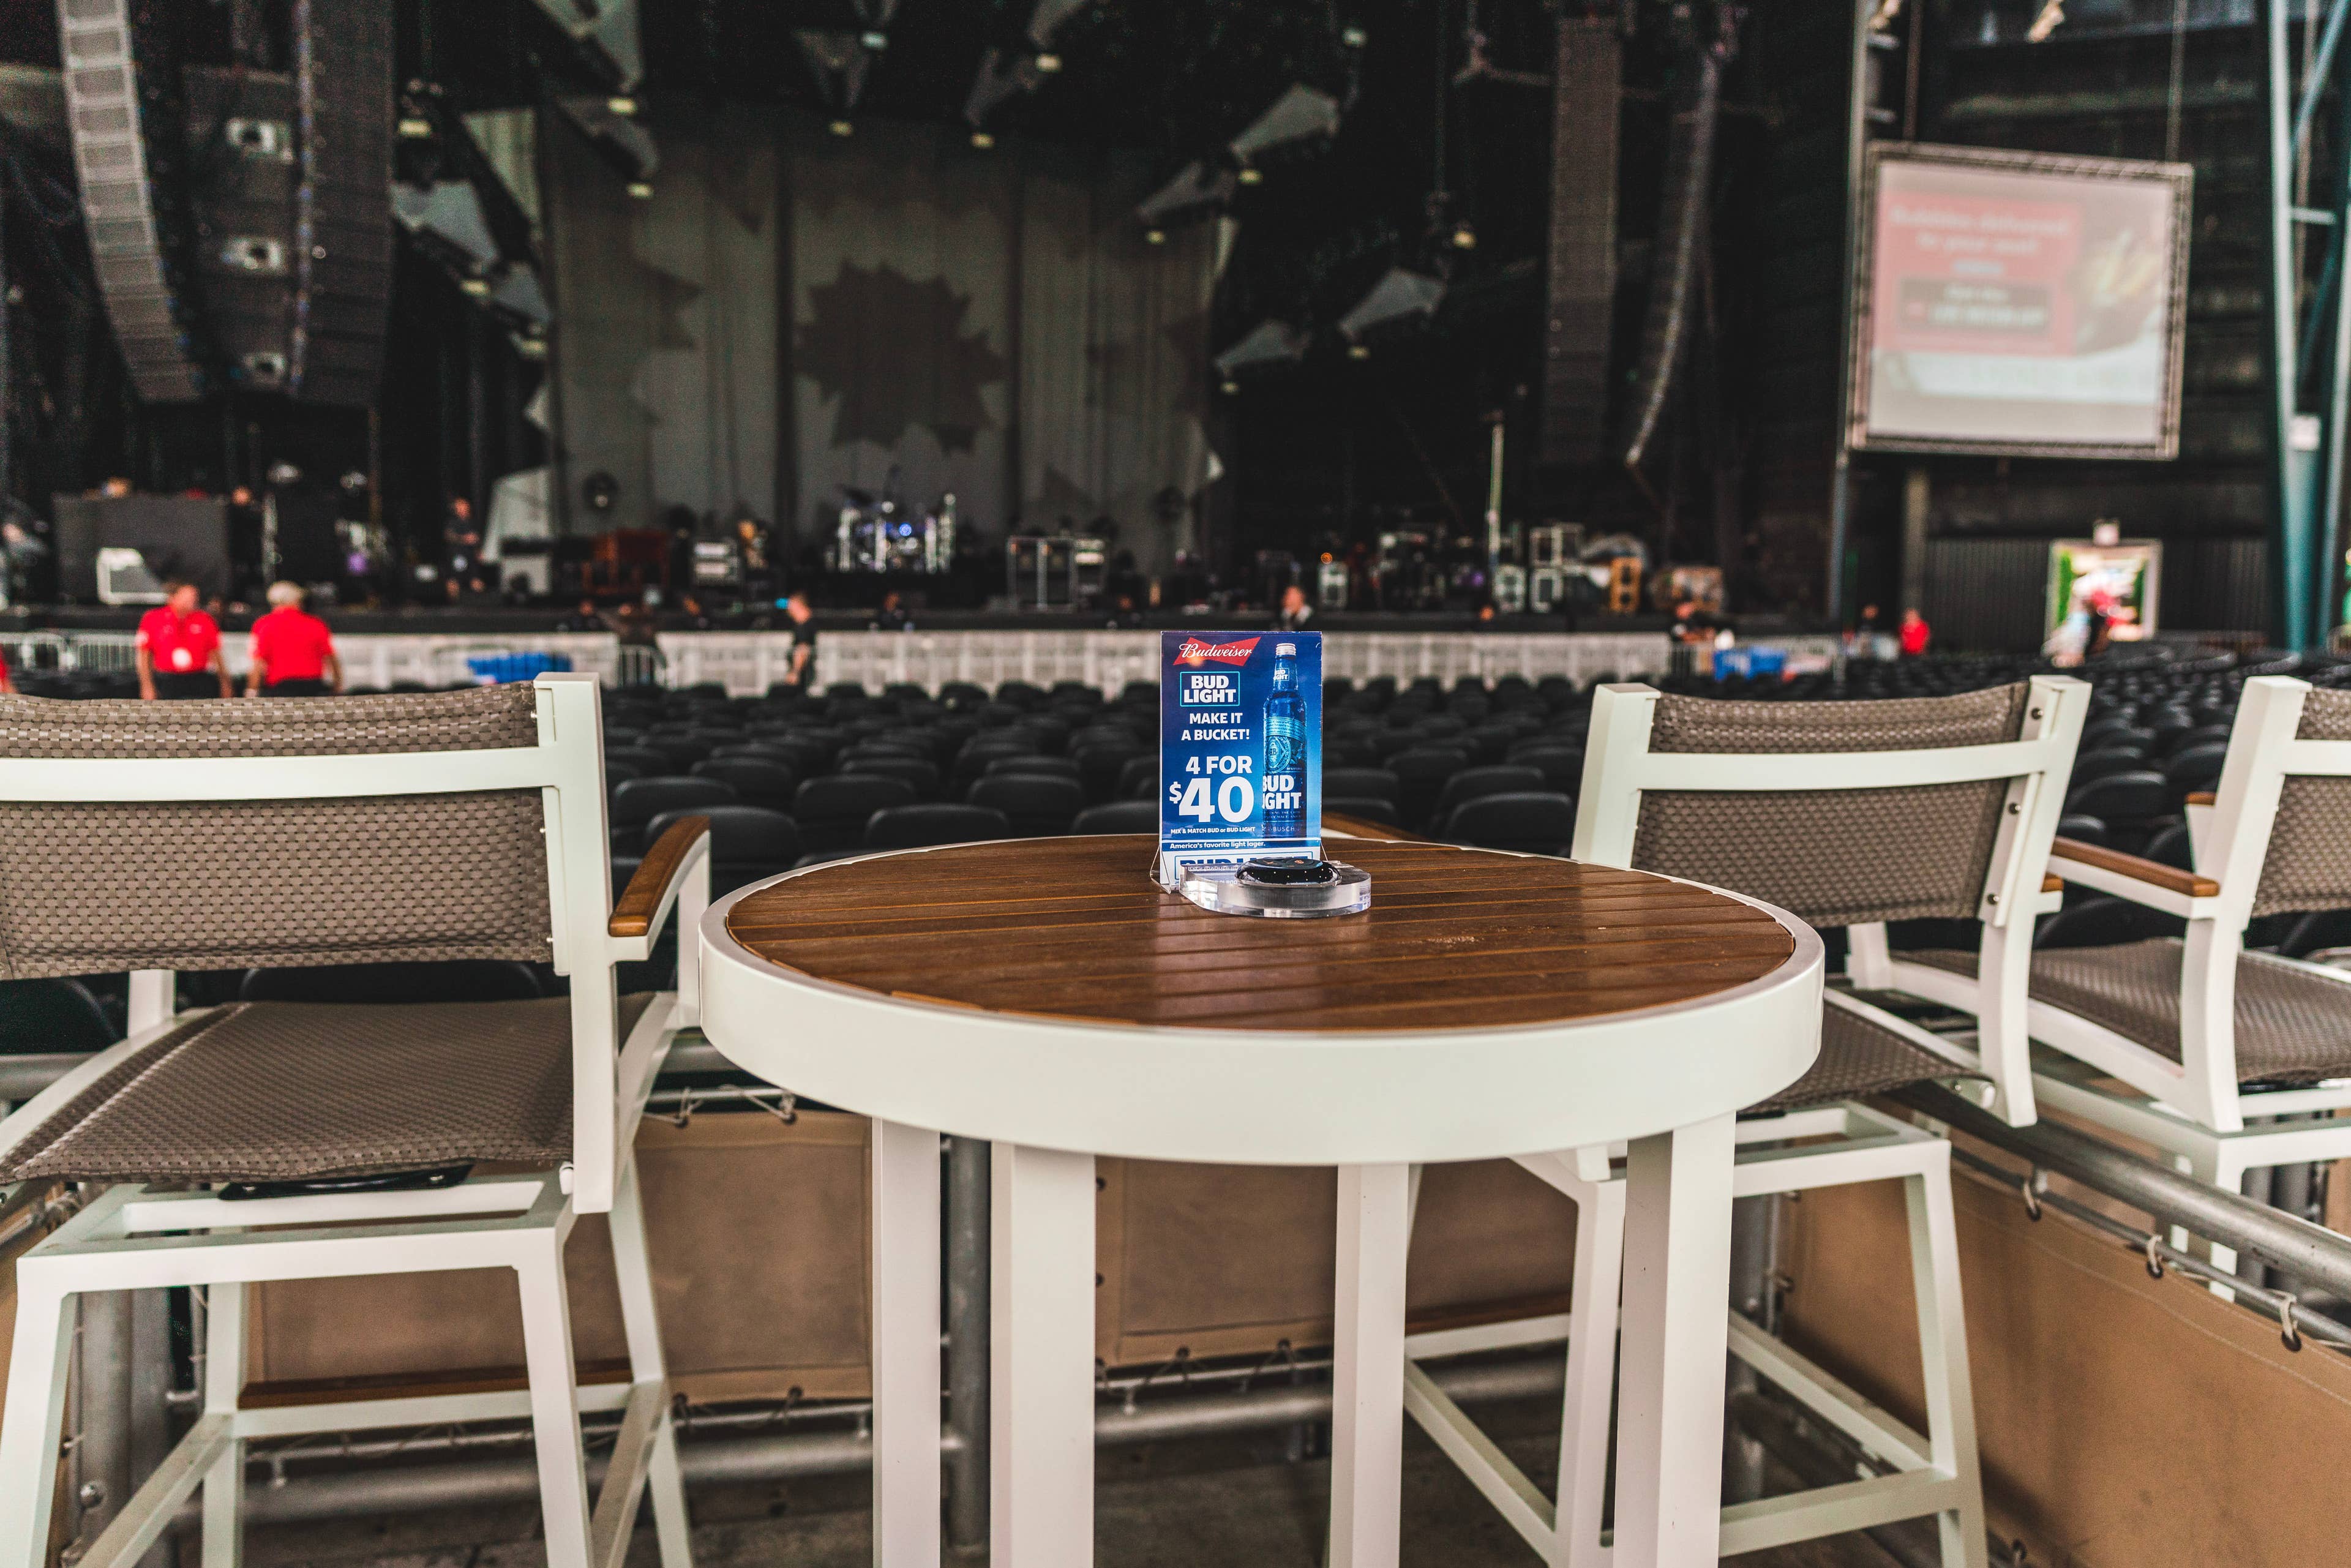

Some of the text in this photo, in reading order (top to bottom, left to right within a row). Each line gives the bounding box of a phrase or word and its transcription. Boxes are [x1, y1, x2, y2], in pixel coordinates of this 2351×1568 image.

[1179, 643, 1252, 658] Budweiser
[1191, 675, 1229, 689] BUD
[1183, 689, 1237, 703] LIGHT
[1190, 712, 1243, 724] MAKE IT
[1181, 729, 1250, 741] A BUCKET!
[1185, 755, 1253, 775] 4 FOR
[1169, 776, 1254, 823] $40
[1262, 792, 1302, 810] IGHT
